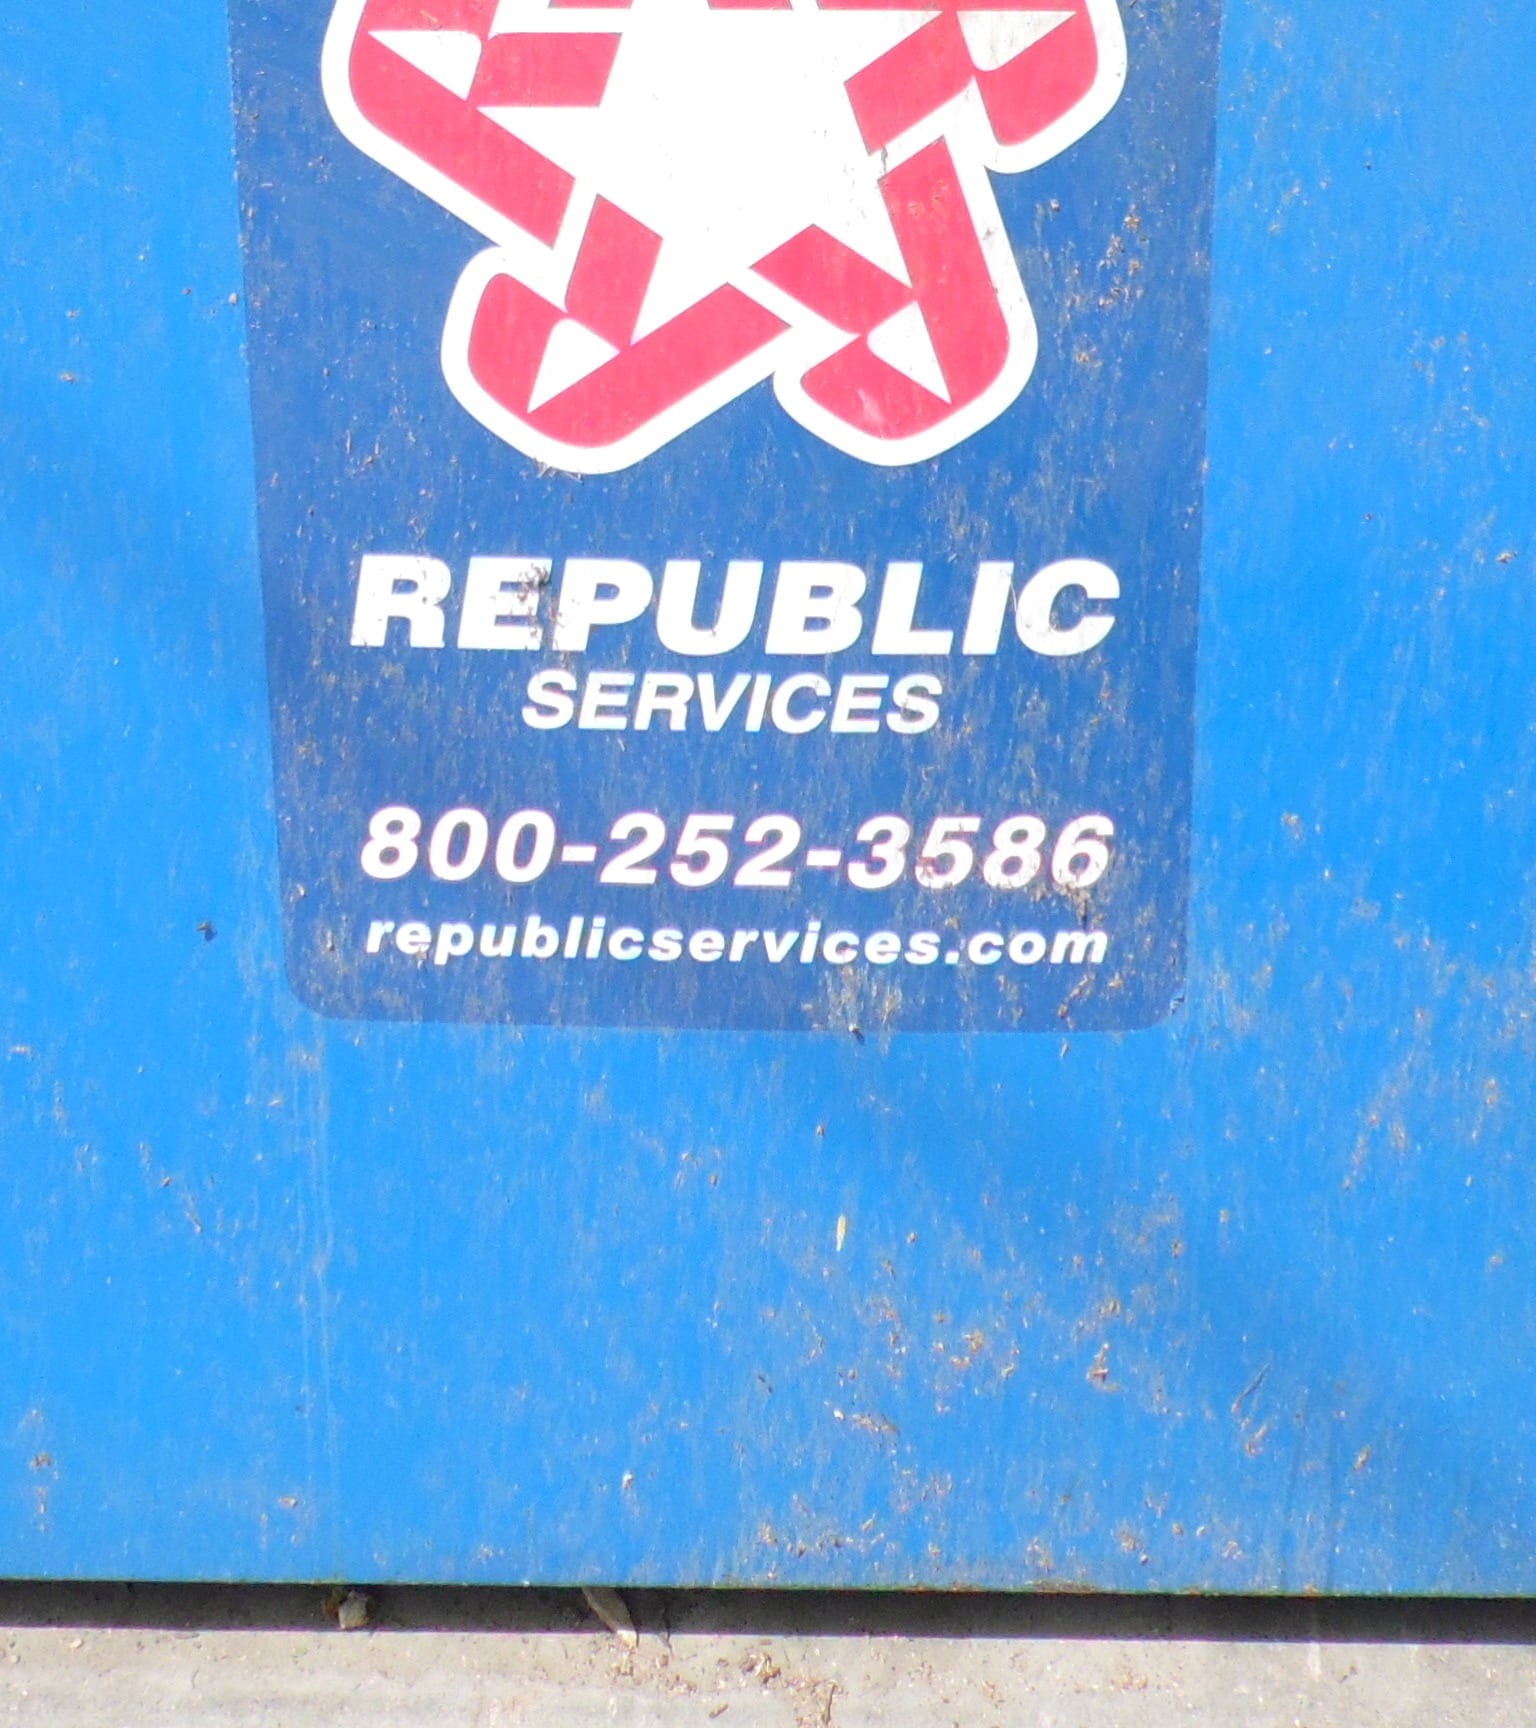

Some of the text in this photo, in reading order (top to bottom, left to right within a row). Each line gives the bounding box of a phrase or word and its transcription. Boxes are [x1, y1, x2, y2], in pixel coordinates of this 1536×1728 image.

[349, 552, 1123, 658] REPUBLIC
[519, 670, 944, 736] SERVICES
[359, 805, 1116, 892] 800-252-3586
[365, 914, 1110, 968] republicservices.com
